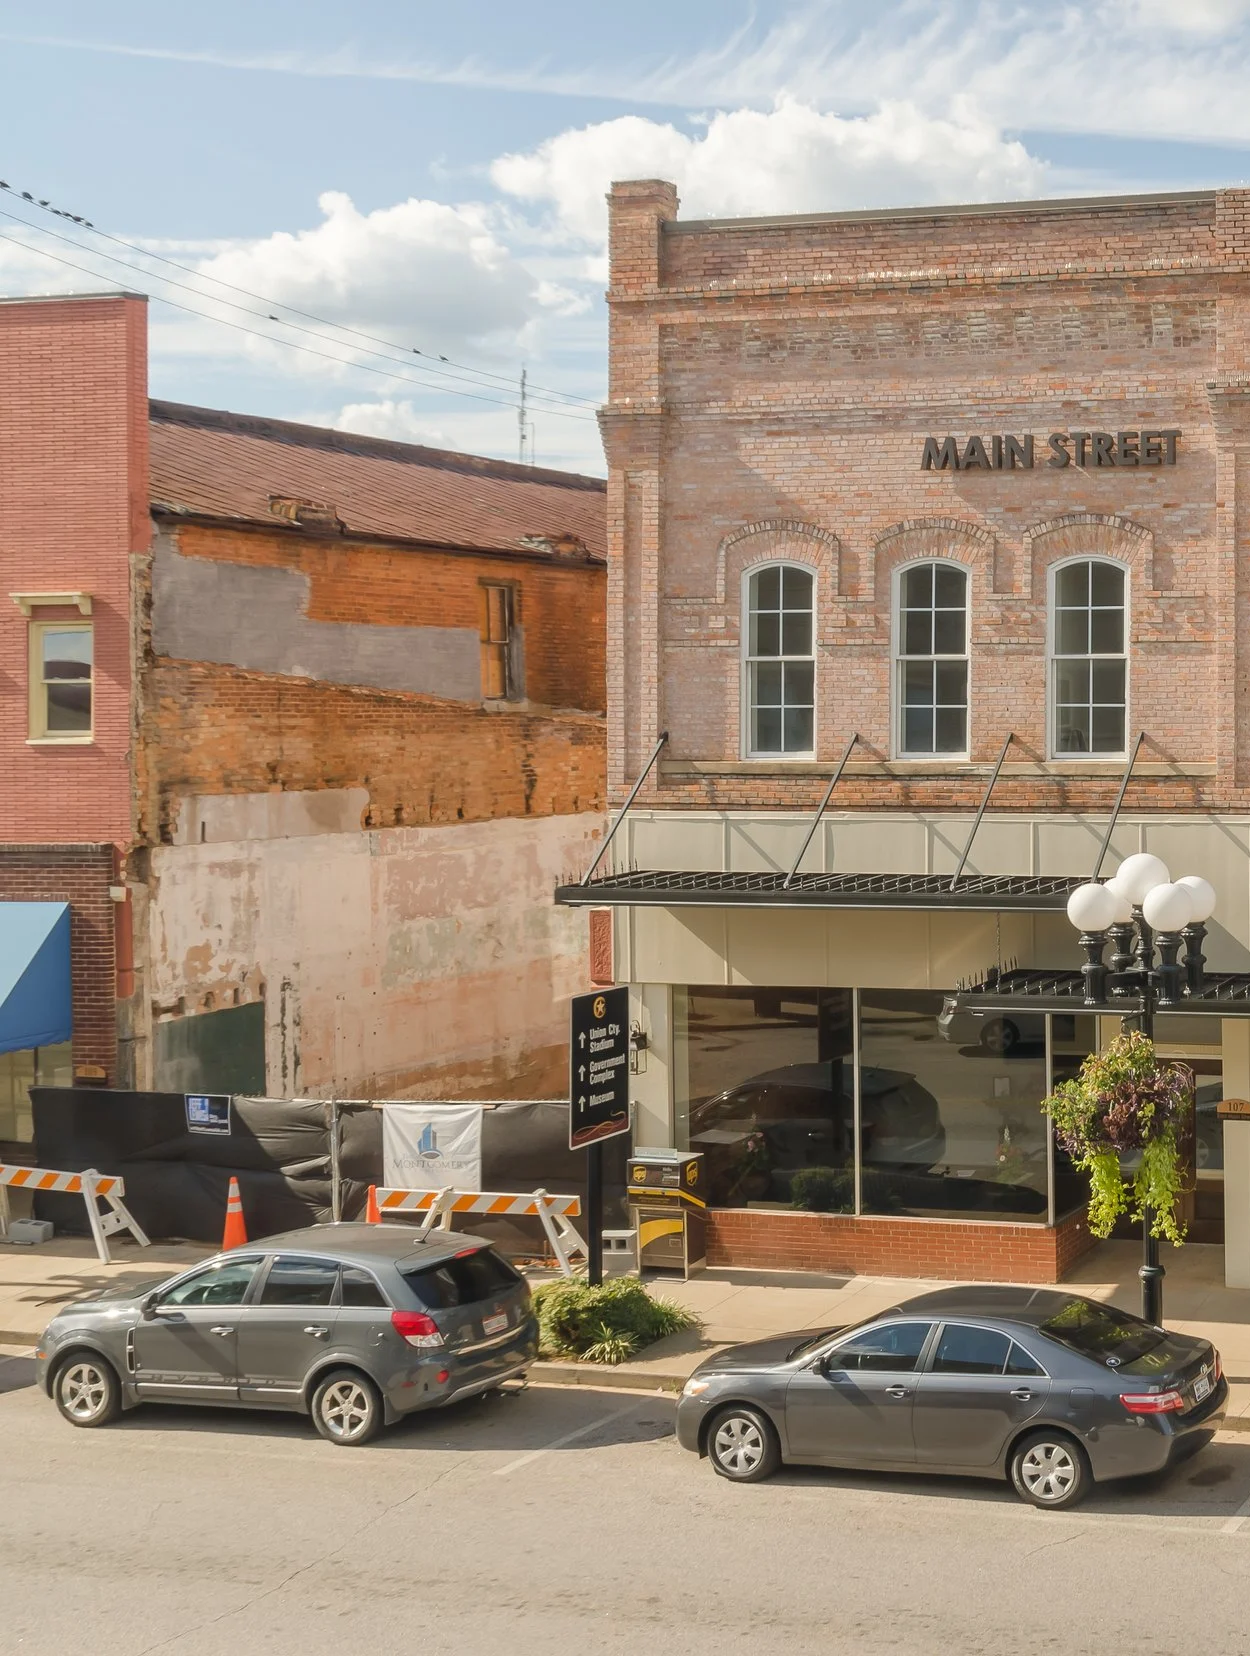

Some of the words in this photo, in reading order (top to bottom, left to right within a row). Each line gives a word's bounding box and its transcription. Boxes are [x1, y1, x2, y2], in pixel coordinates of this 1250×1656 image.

[921, 434, 1034, 470] MAIN
[1048, 430, 1182, 468] STREET
[590, 1027, 607, 1040] Union
[590, 1039, 615, 1053] Stadium
[590, 1053, 625, 1073] Government
[590, 1069, 615, 1085] Complex
[590, 1091, 615, 1107] Museum
[1229, 1102, 1244, 1111] 107
[392, 1159, 471, 1169] MONTGOMERY
